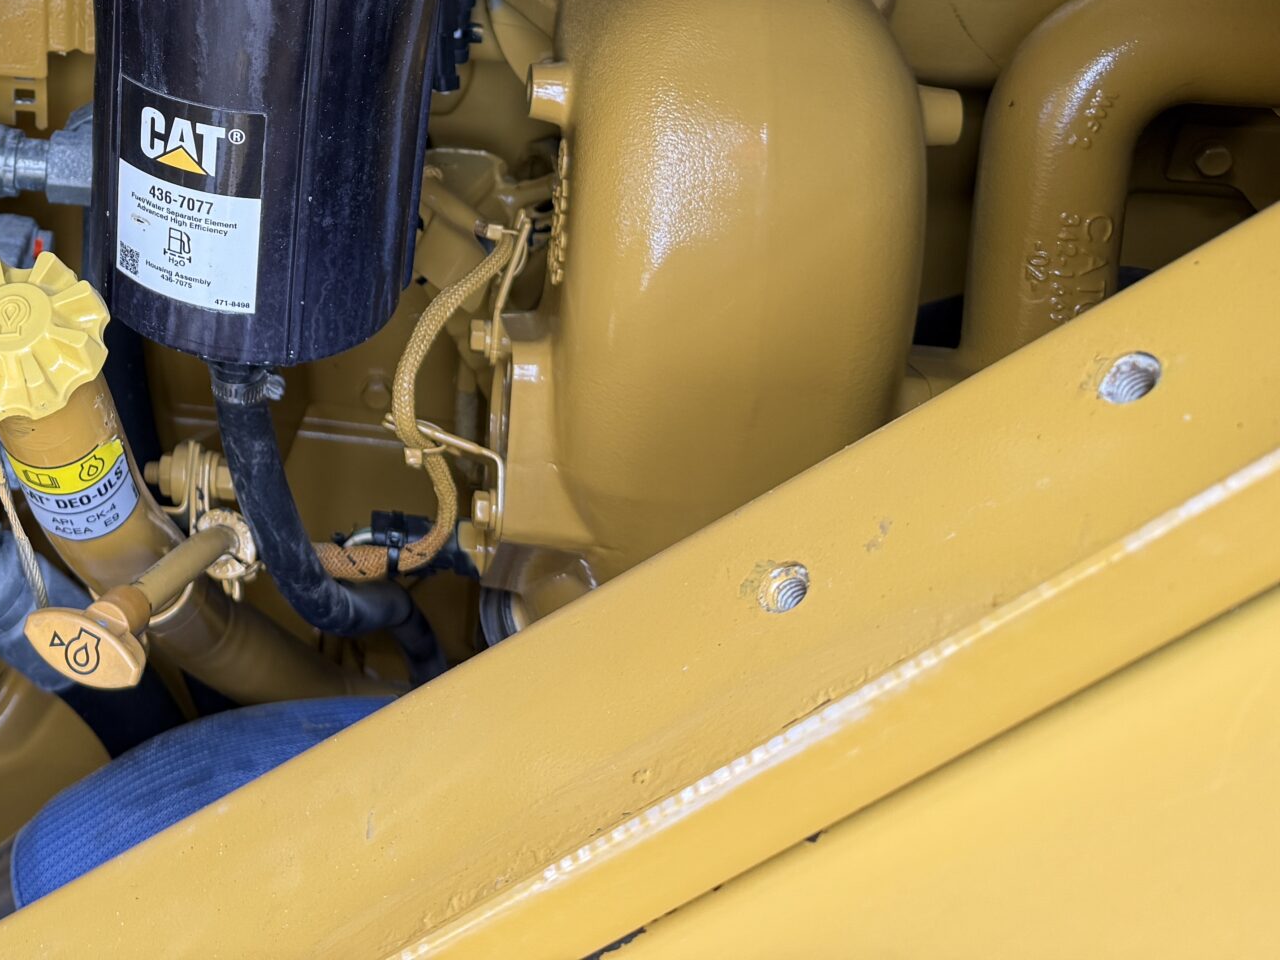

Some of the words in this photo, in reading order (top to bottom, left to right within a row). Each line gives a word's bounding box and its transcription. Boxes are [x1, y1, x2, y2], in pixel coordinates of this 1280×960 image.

[131, 191, 164, 212] Fuel/Water
[166, 207, 203, 223] Separator
[204, 217, 238, 230] Element
[149, 185, 214, 215] 436-7077
[137, 202, 169, 221] Advanced
[170, 215, 188, 227] High
[189, 220, 229, 237] Efficiency
[145, 259, 173, 276] Housing
[174, 271, 212, 287] Assembly
[160, 274, 193, 289] 436-7075
[51, 516, 74, 526] API
[86, 503, 117, 523] CK-4
[55, 525, 93, 535] ACEA
[104, 512, 120, 527] E9
